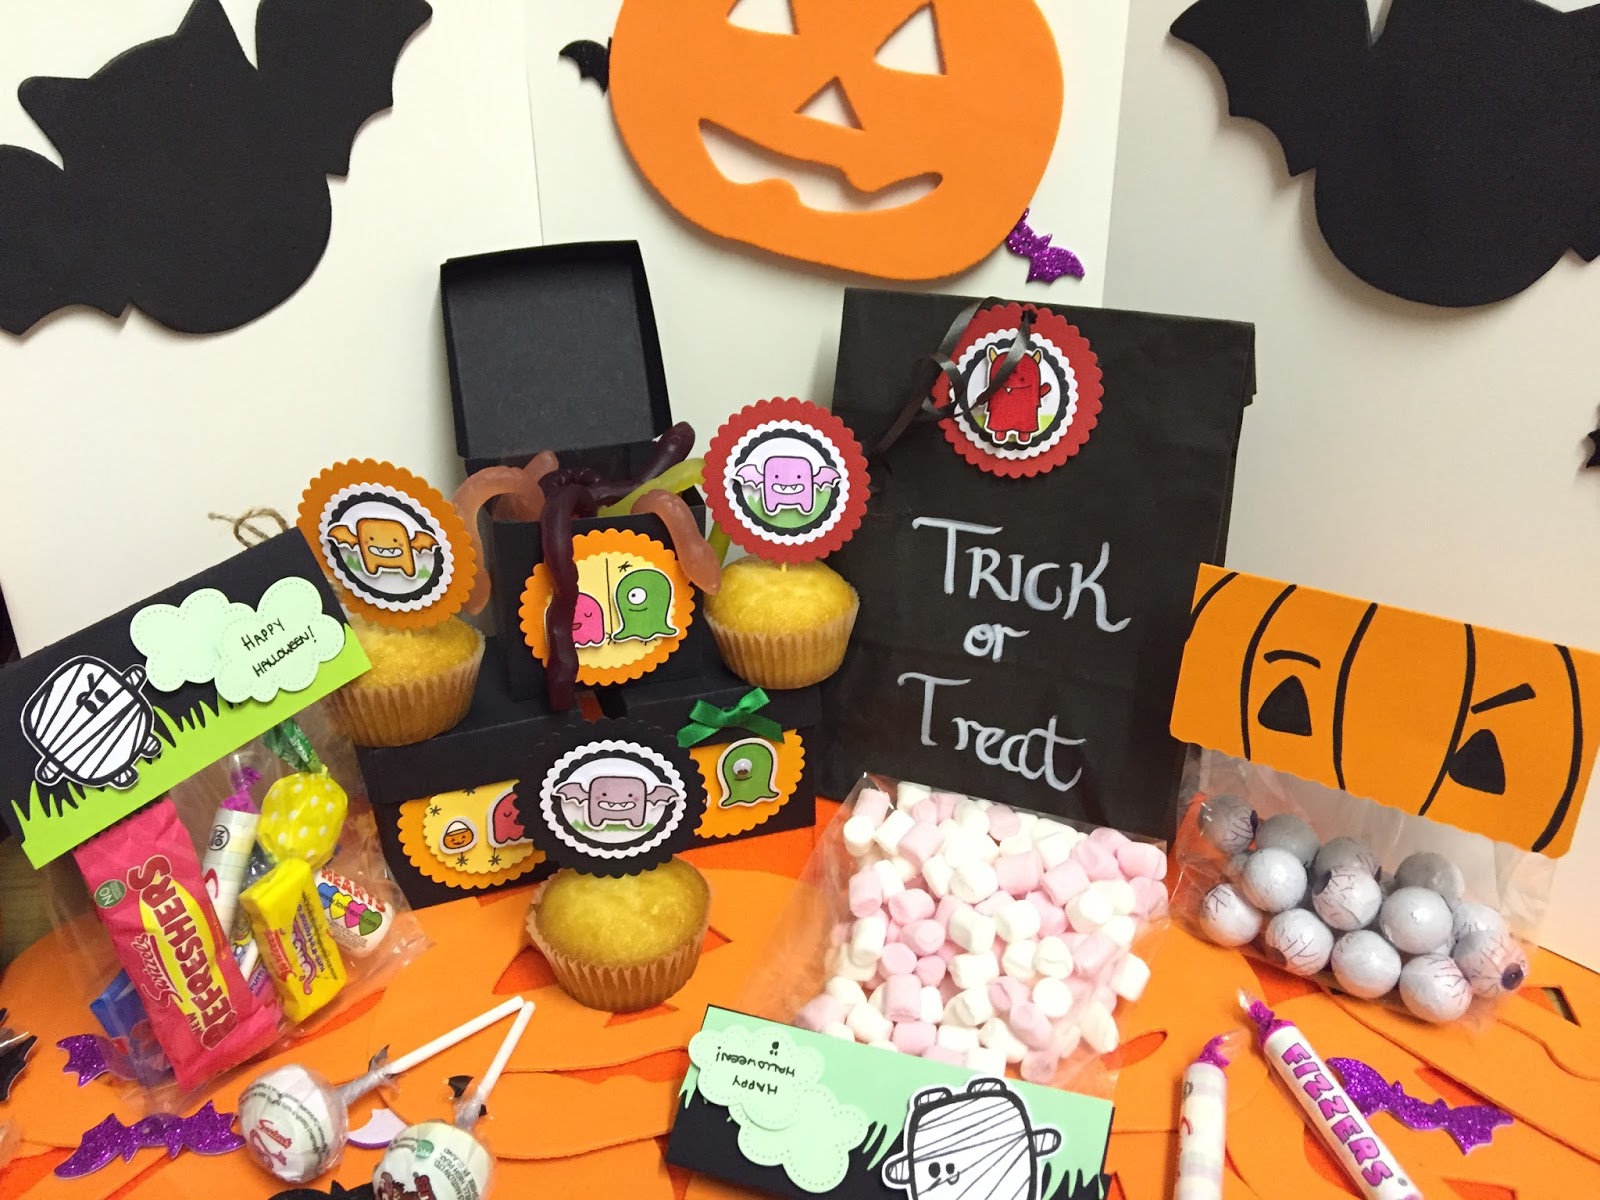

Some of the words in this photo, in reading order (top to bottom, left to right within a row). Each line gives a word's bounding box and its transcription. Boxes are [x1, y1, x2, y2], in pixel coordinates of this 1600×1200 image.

[241, 617, 285, 652] HAPPY
[963, 623, 1030, 663] or
[897, 671, 1087, 792] Treat
[98, 887, 115, 906] NO
[126, 854, 238, 1051] REFRESHERS
[130, 933, 185, 1009] Swizzels
[732, 1074, 778, 1095] HAPPY
[1281, 1042, 1394, 1188] FIZZERS
